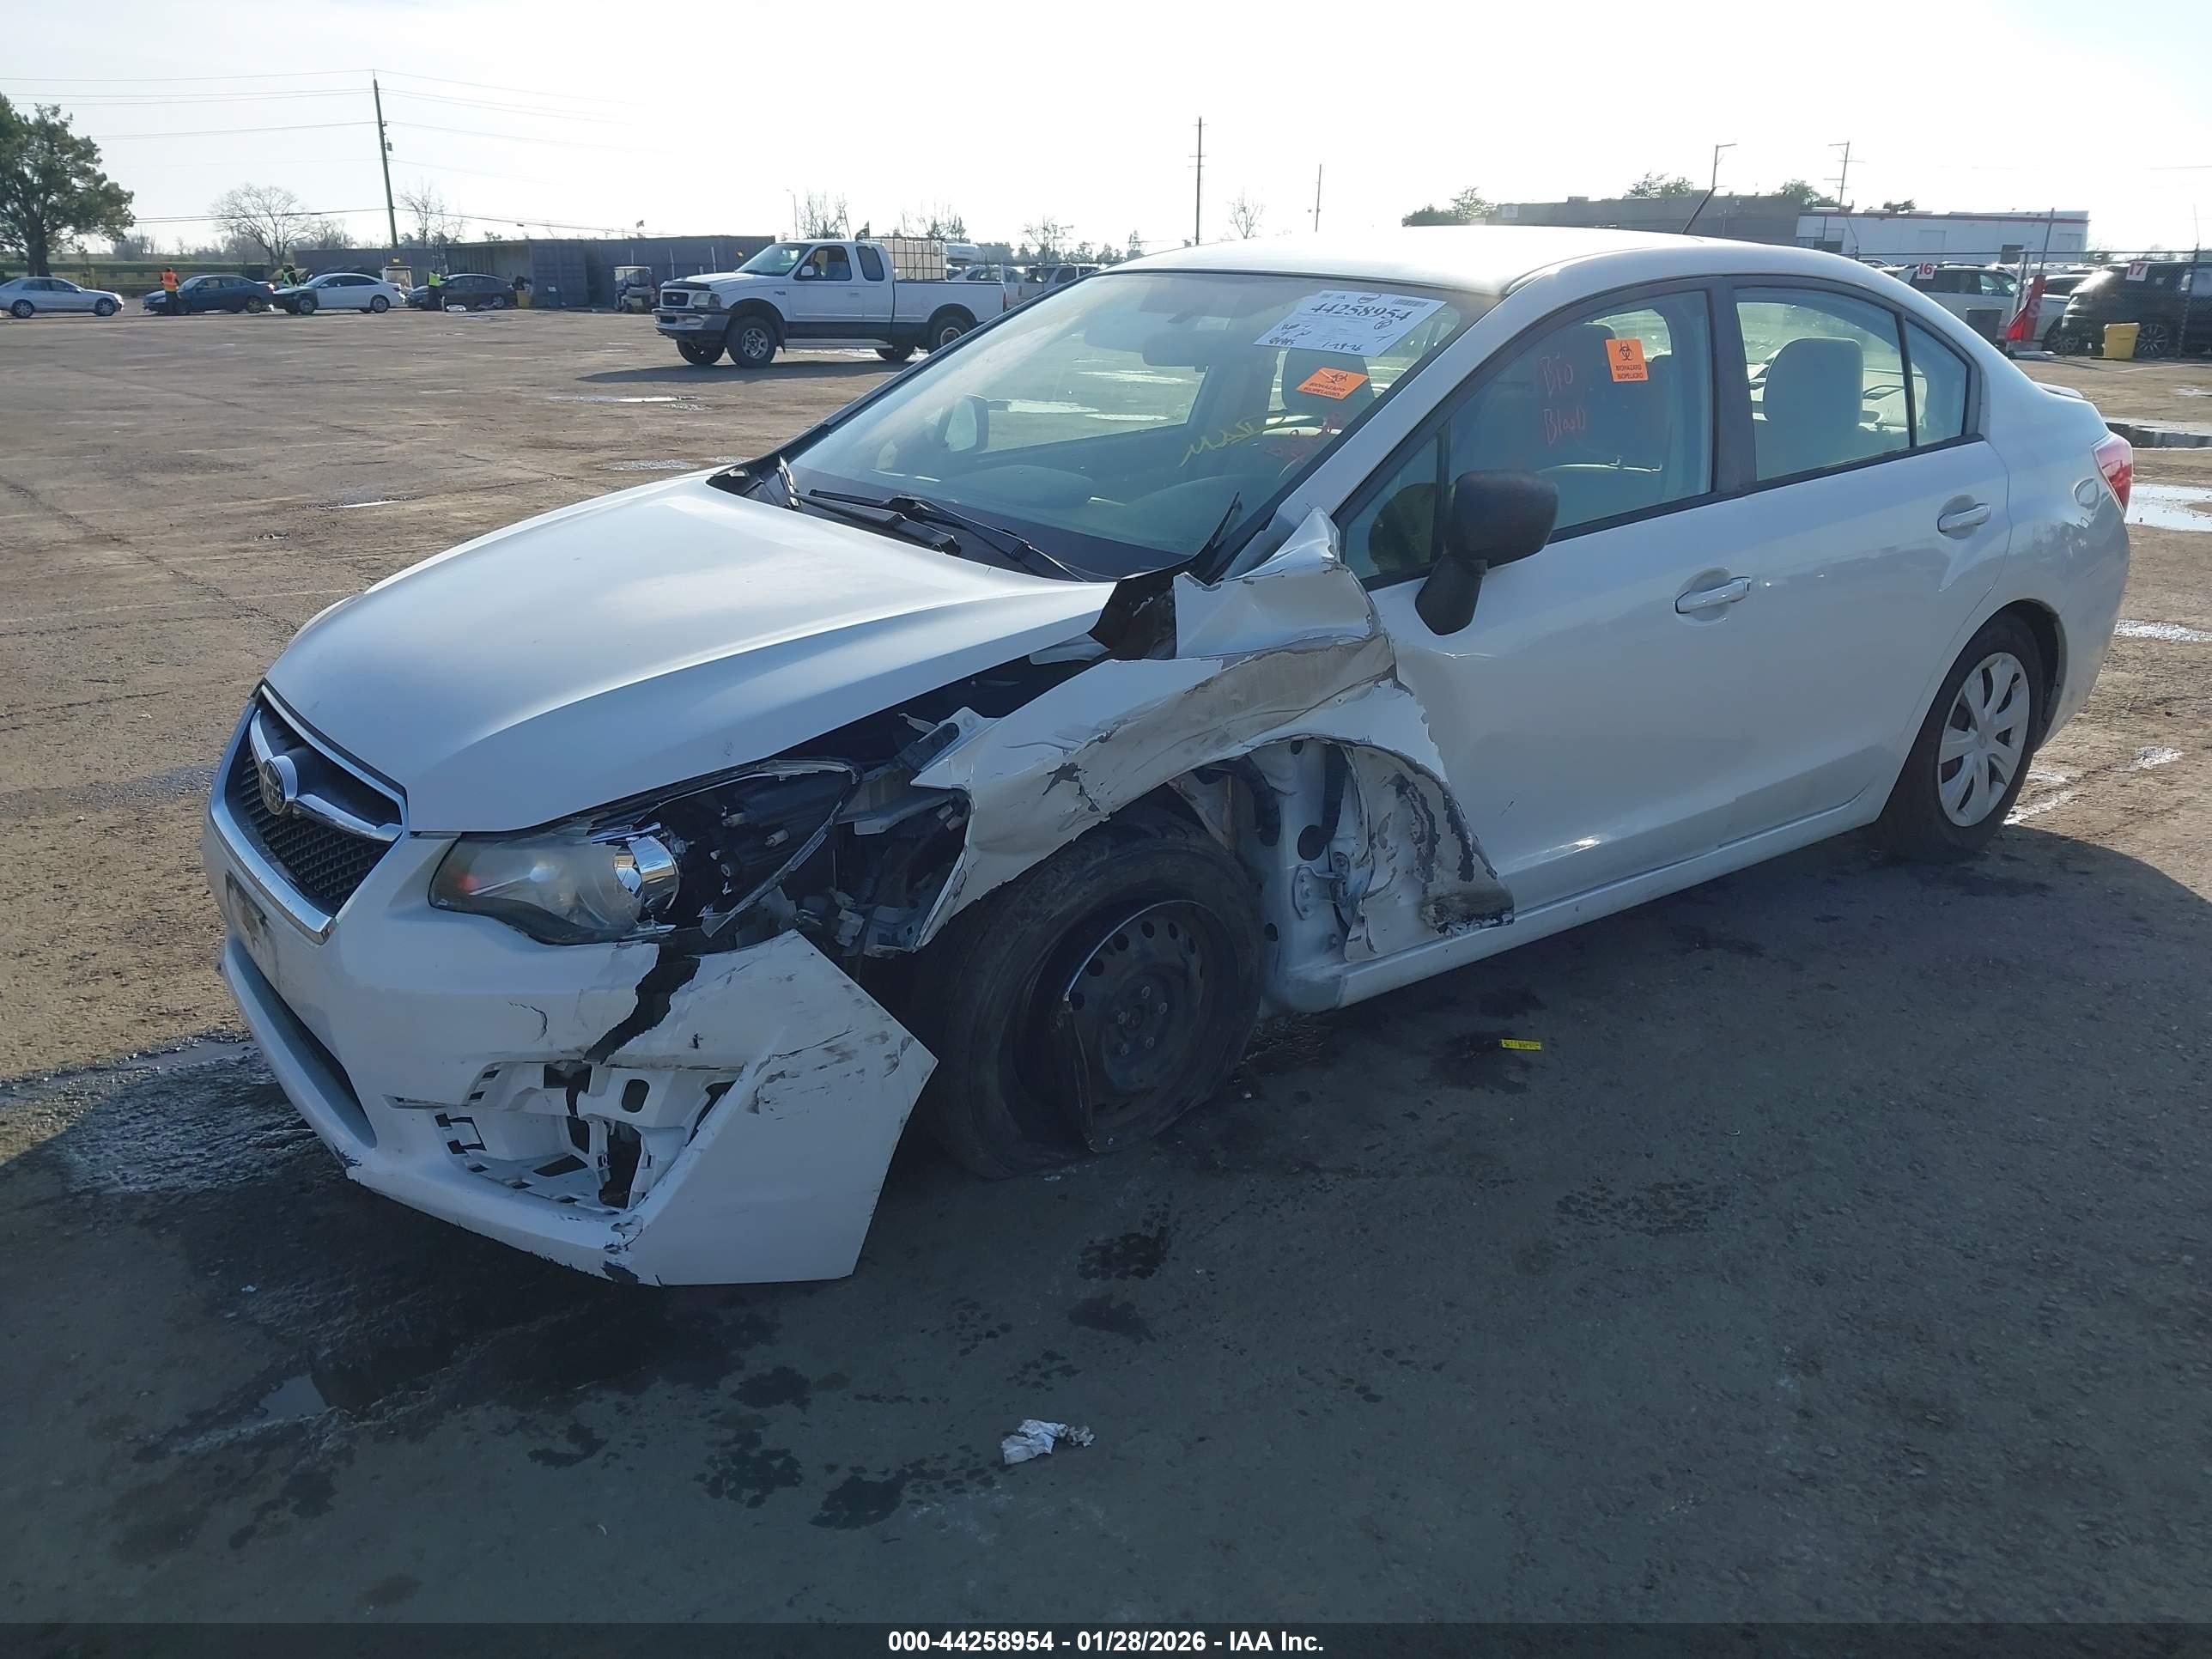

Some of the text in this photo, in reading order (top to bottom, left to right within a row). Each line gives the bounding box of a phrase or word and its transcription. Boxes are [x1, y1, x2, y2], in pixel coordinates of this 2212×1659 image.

[1918, 263, 1933, 275] 16
[2130, 262, 2146, 276] 17
[1310, 302, 1413, 322] 44258954
